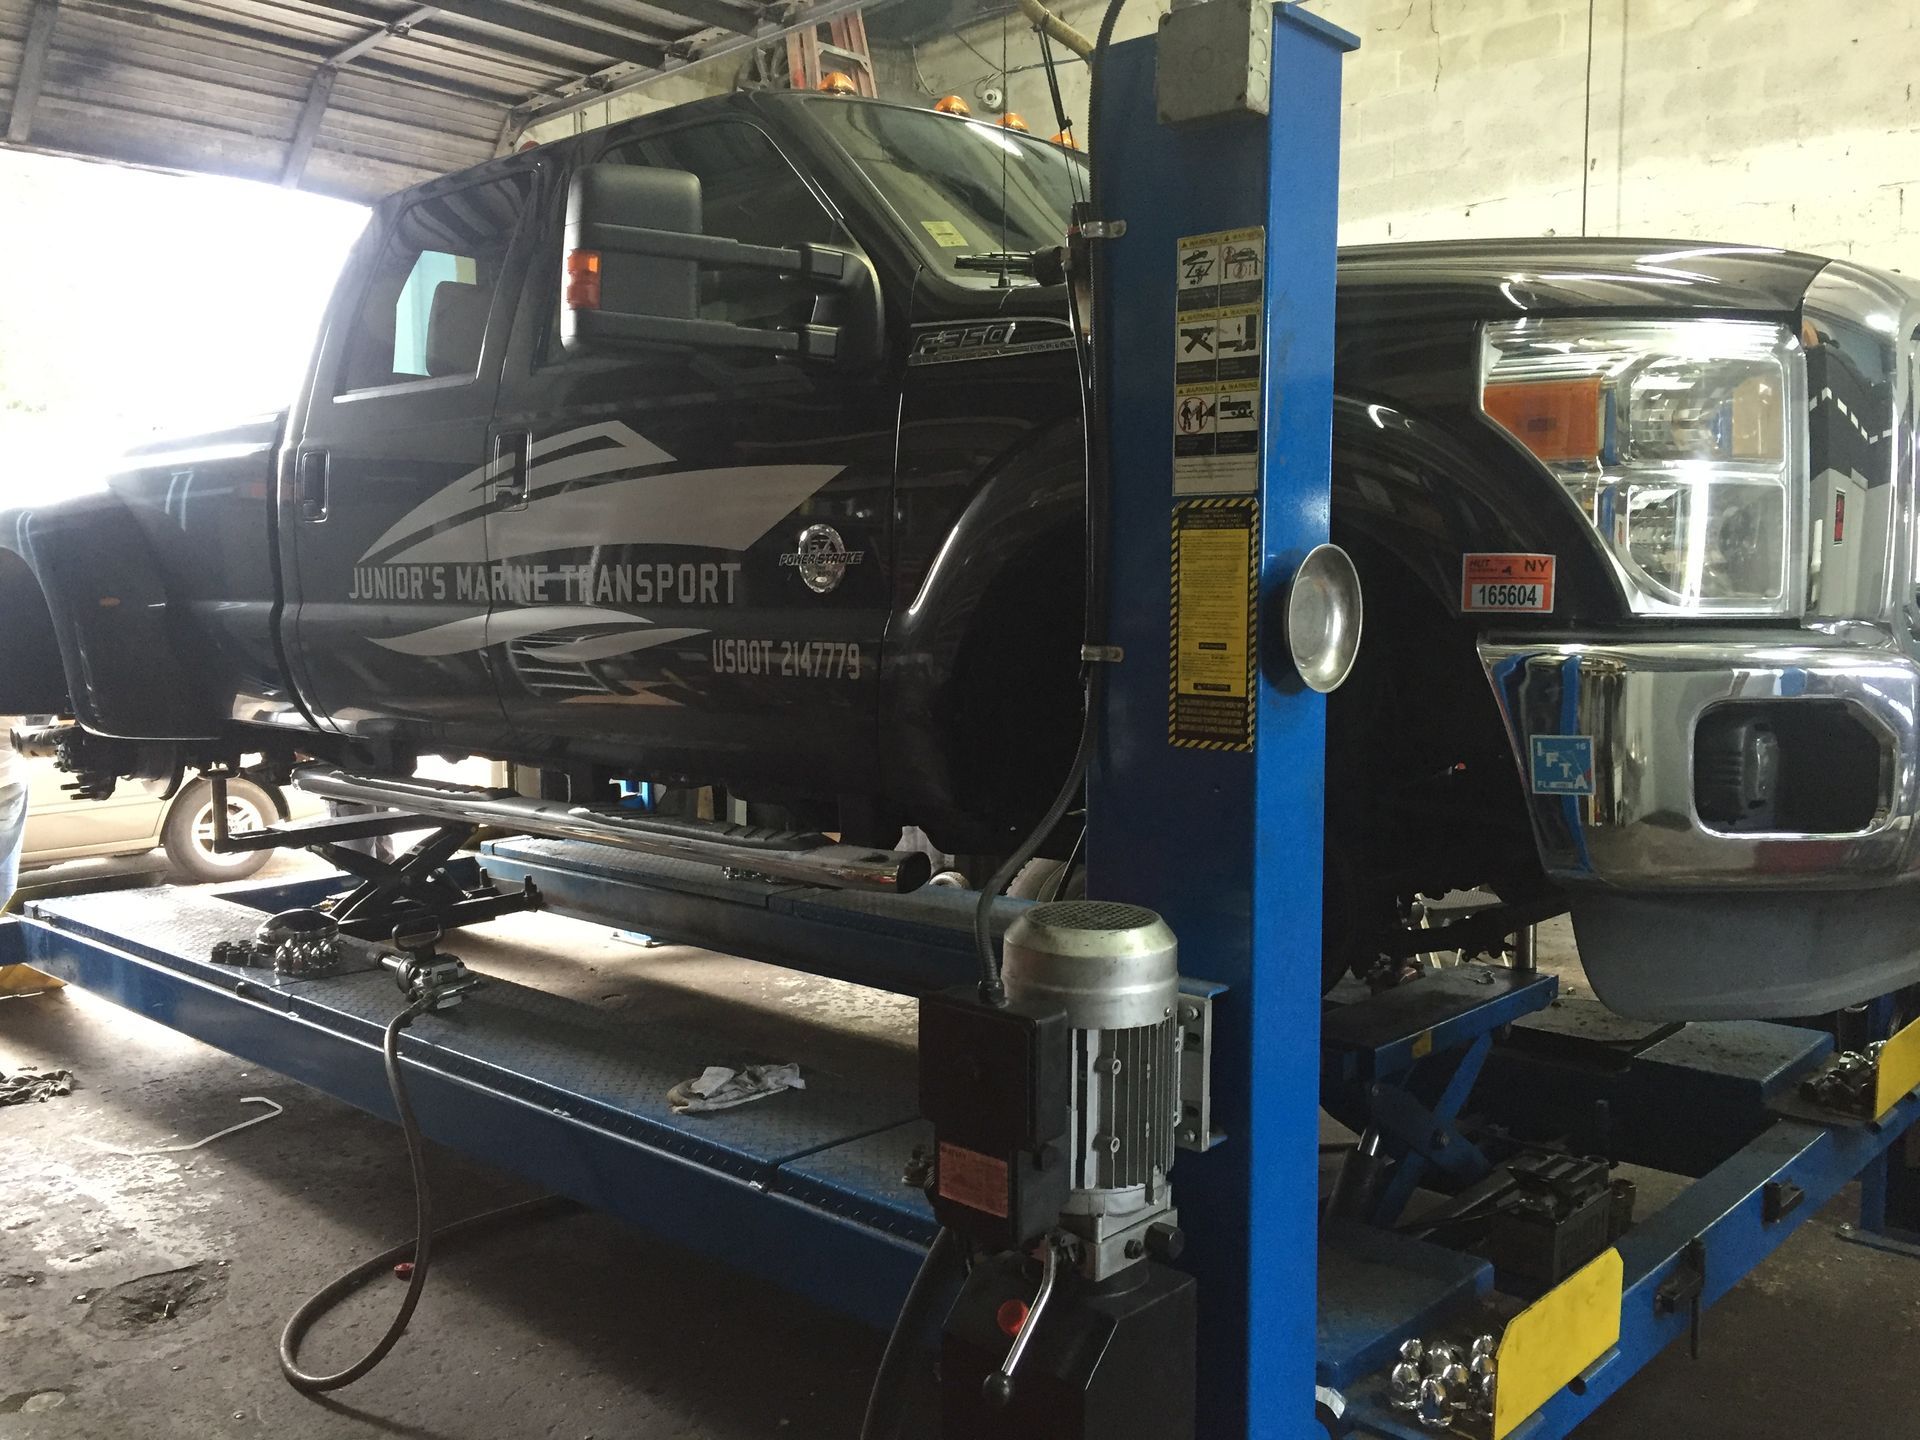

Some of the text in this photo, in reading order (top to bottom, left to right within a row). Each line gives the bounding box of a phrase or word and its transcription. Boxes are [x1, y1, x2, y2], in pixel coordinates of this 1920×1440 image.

[1186, 385, 1214, 394] WARNING
[1228, 381, 1258, 391] WARNING
[779, 551, 865, 566] POWER STROKE
[1525, 559, 1549, 572] NY
[349, 563, 742, 604] JUNIOR'S MARINE TRANSPORT
[1479, 585, 1537, 606] 165604
[713, 639, 860, 680] USDOT 2147779
